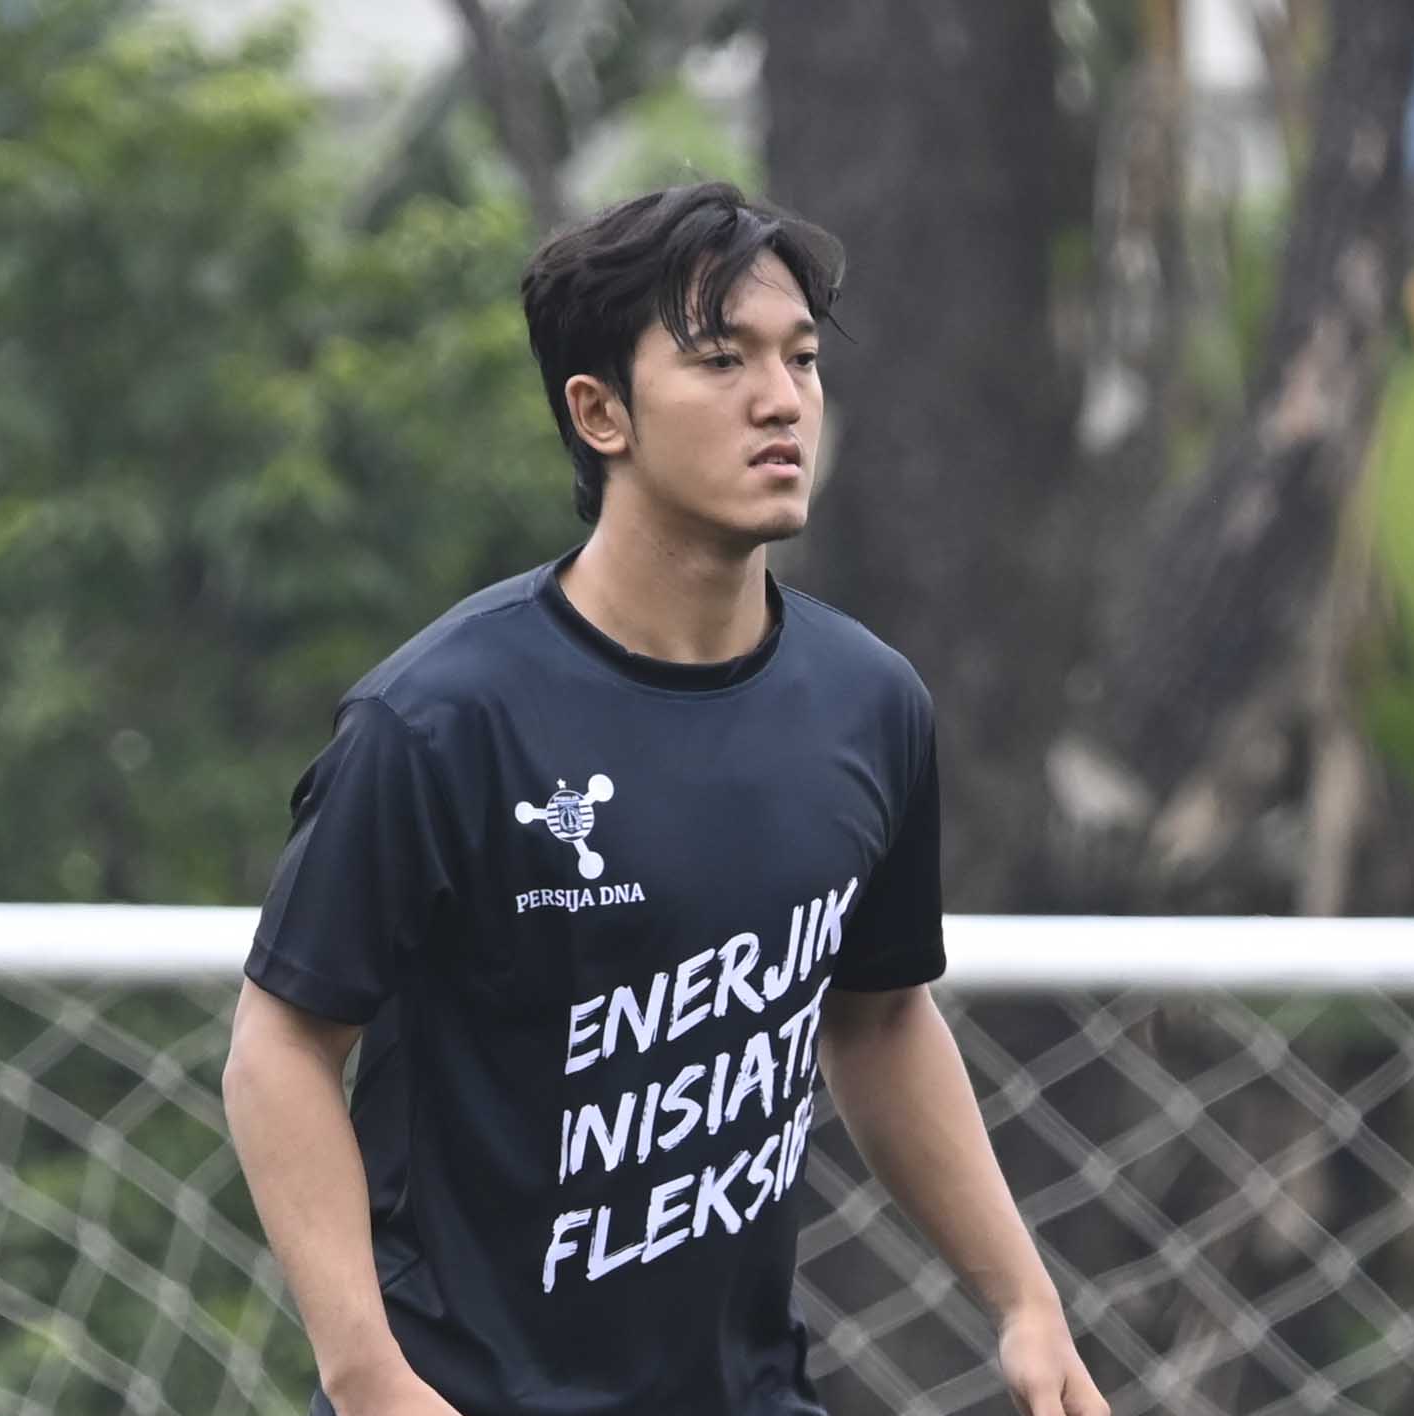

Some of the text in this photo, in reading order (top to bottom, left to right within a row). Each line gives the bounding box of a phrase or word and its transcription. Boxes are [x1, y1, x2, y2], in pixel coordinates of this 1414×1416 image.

[515, 882, 646, 913] PERSIJA DNA
[565, 876, 858, 1075] ENERJIK
